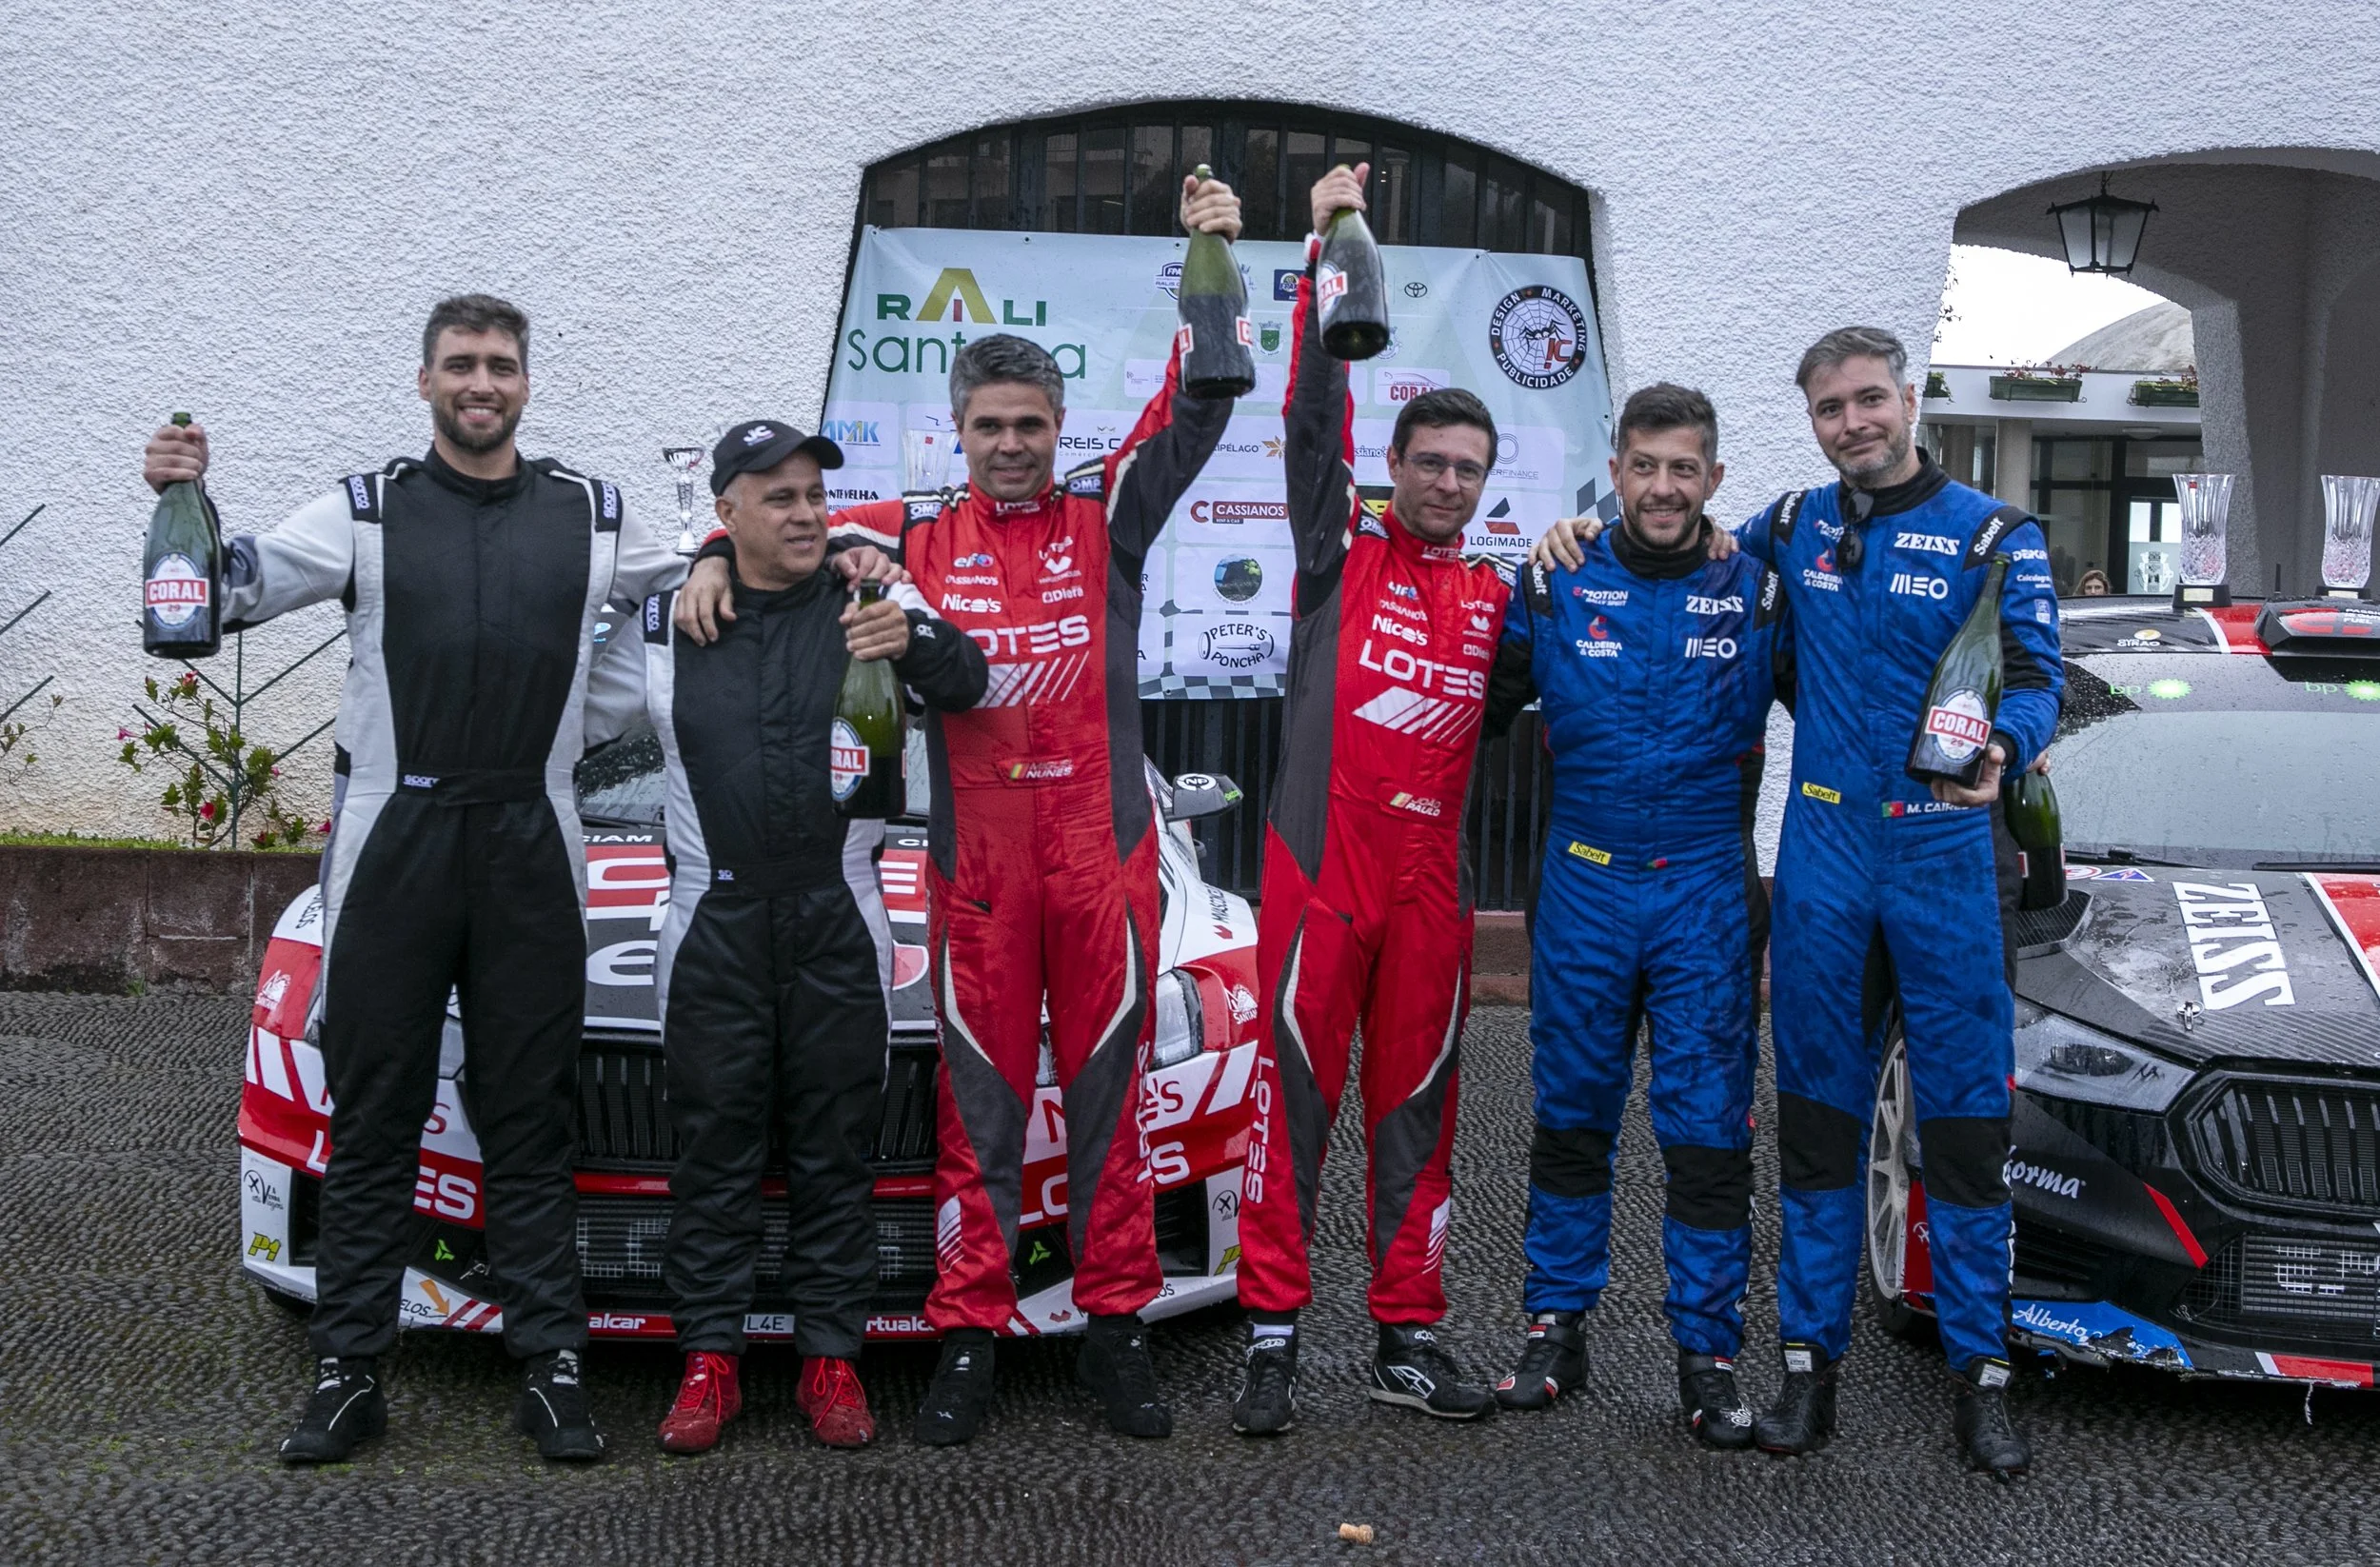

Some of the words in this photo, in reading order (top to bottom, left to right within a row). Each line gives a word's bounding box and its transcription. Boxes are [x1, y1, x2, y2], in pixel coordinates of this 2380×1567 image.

[877, 268, 1046, 327] RALI
[1491, 292, 1520, 336] DESIGN
[1541, 288, 1586, 351] MARKETING
[847, 328, 1086, 379] Santa
[1497, 352, 1574, 387] PUBLICIDADE
[1059, 437, 1103, 449] REIS
[1215, 443, 1259, 452] IPÉLAGO
[1354, 446, 1387, 457] ssiano's
[1490, 468, 1538, 478] ERFINANCE
[1069, 477, 1101, 492] OMP
[1216, 504, 1285, 517] CASSIANOS
[1470, 536, 1533, 548] LOGIMADE
[1894, 532, 1960, 556] ZEISS
[1973, 517, 2004, 556] Sabelt
[1803, 568, 1843, 585] CALDEIRA
[1812, 579, 1839, 592] COSTA
[149, 581, 204, 602] CORAL
[1761, 571, 1779, 611] Sabelt
[1685, 595, 1743, 615] ZEISS
[964, 615, 1091, 658] OTES
[1209, 623, 1268, 641] PETER'S
[1576, 639, 1622, 651] CALDEIRA
[1588, 649, 1618, 658] COSTA
[1210, 651, 1265, 668] PONCHA
[1359, 639, 1485, 700] LOTES
[2110, 684, 2141, 697] bp
[2305, 682, 2338, 695] bp
[1934, 712, 1985, 742] CORAL
[1025, 765, 1073, 779] NUNES
[1805, 784, 1836, 802] Sabelt
[1405, 803, 1441, 817] PAULO
[1574, 843, 1606, 863] Sabelt
[2172, 882, 2296, 1010] ZEISS
[1245, 1056, 1274, 1204] LOTES
[588, 1313, 645, 1330] alcar
[2013, 1303, 2089, 1337] Alberto
